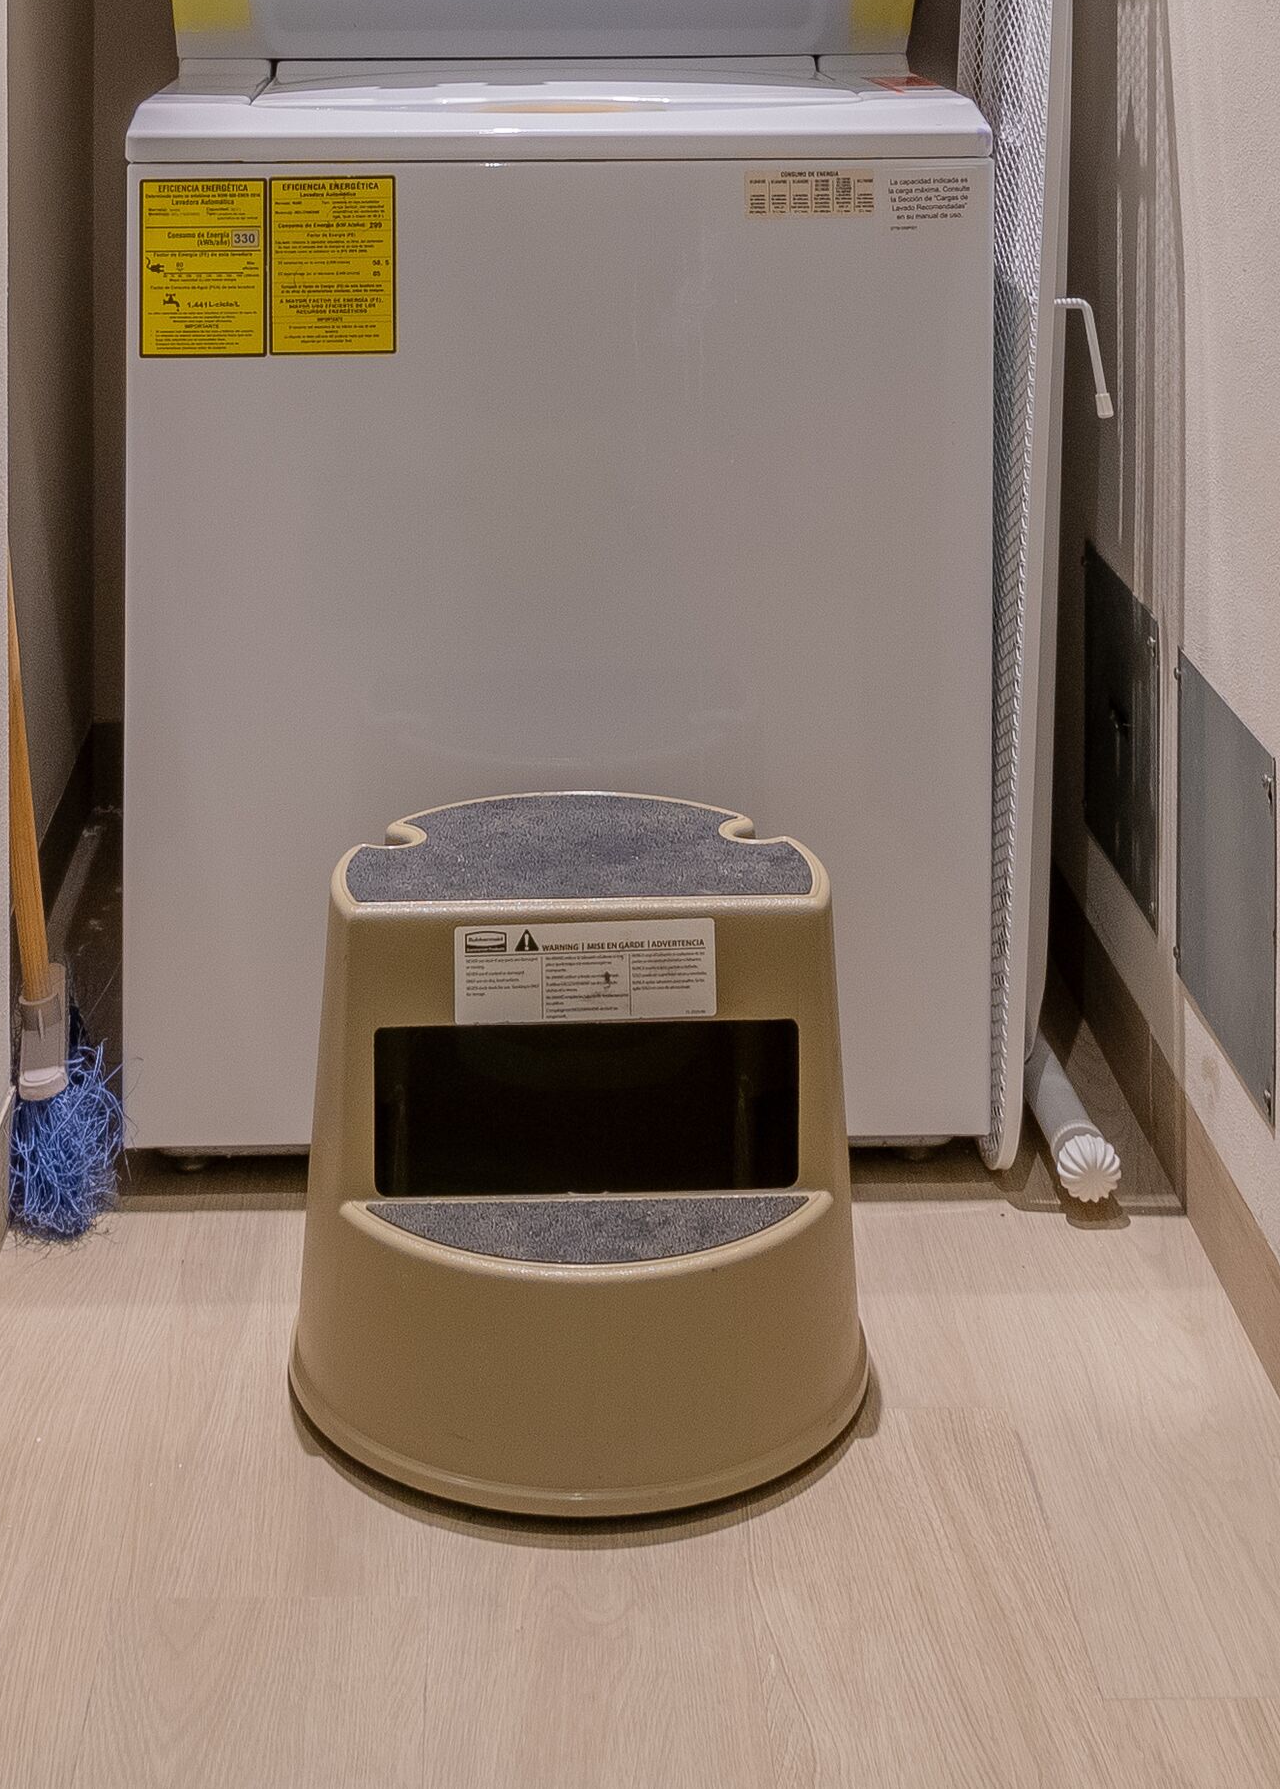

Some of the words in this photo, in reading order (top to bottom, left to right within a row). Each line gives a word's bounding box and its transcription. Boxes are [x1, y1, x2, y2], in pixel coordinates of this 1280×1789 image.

[282, 183, 326, 191] EFICIENCIA
[329, 181, 379, 190] ENERGÉTICA
[899, 178, 931, 186] capacidad
[158, 184, 200, 193] EFICIENCIA
[201, 183, 248, 192] ENERGÉTICA
[895, 187, 913, 195] carga
[892, 204, 915, 212] Lavado
[206, 231, 230, 239] Energía
[234, 233, 256, 244] 330
[542, 944, 579, 952] WARNING
[586, 942, 605, 950] MISE
[619, 940, 645, 949] GARDE
[651, 938, 705, 948] ADVERTENCIA
